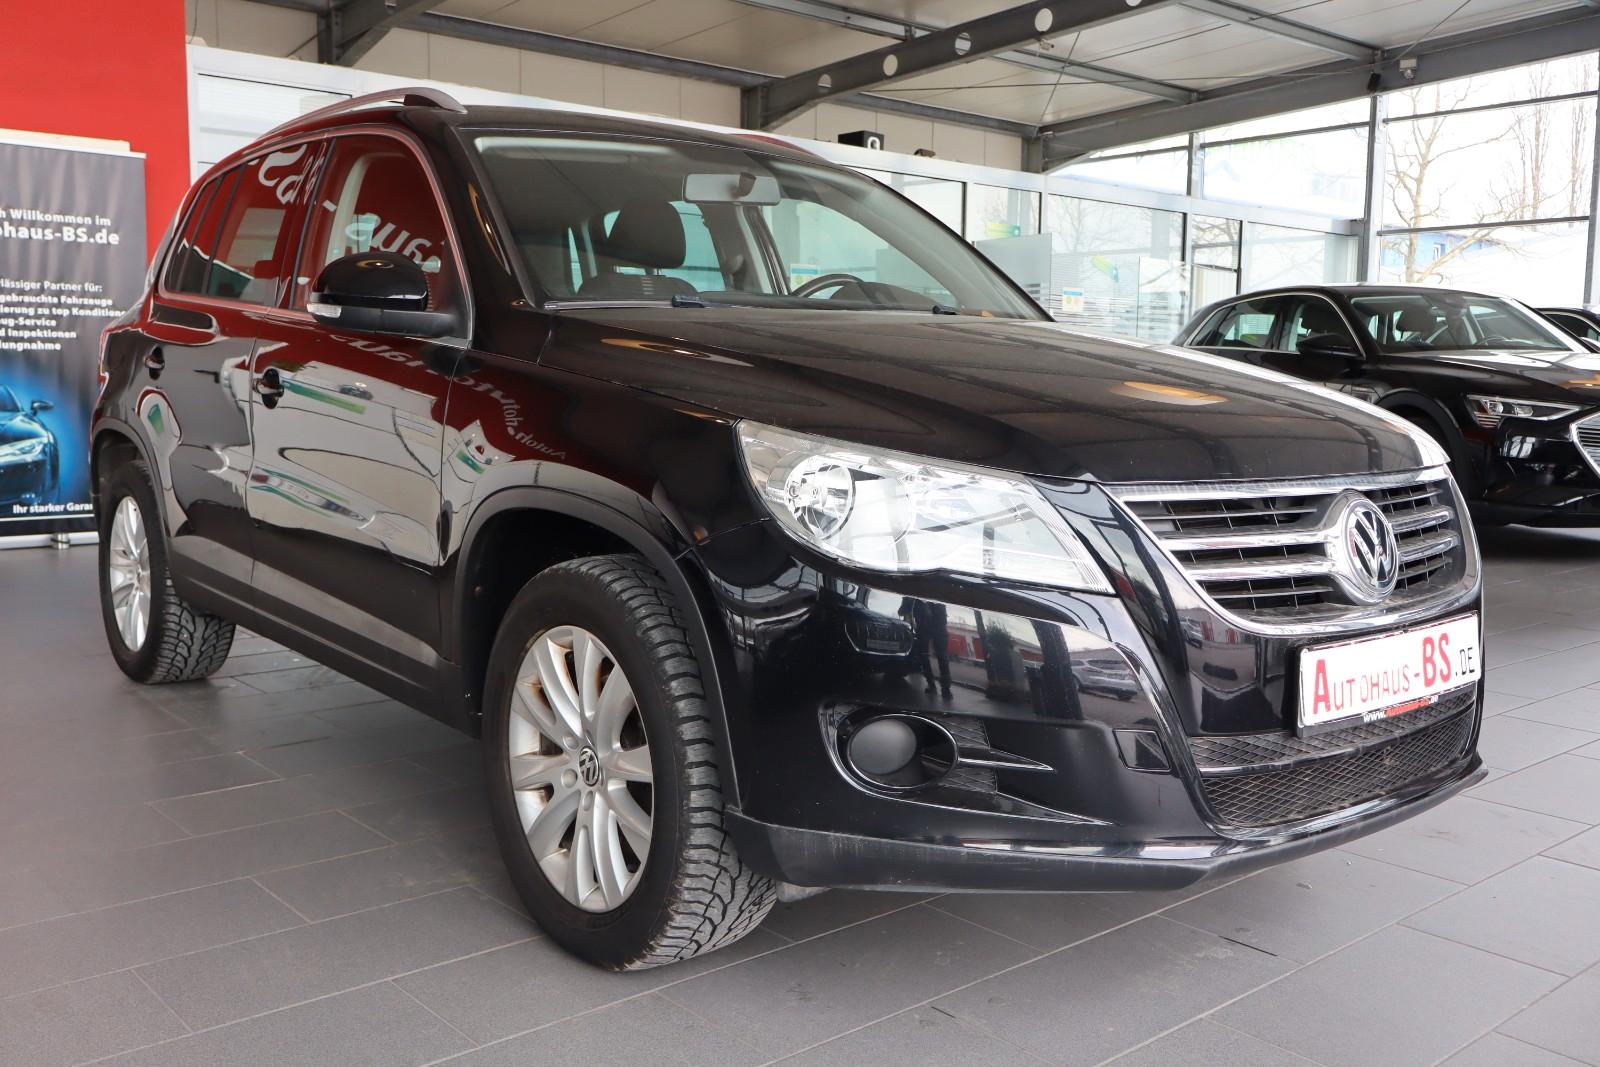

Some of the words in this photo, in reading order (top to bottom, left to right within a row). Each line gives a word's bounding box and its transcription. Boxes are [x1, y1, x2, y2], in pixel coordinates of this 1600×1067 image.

[9, 208, 92, 225] Willkommen
[95, 214, 111, 226] im
[0, 221, 120, 245] haus-BS.de
[43, 281, 82, 292] Partner
[84, 282, 102, 292] für:
[60, 295, 113, 307] Fahrzeuge
[37, 307, 50, 315] zu
[52, 306, 70, 317] top
[8, 328, 77, 339] Inspektionen
[13, 504, 28, 514] Ihr
[29, 503, 65, 513] starker
